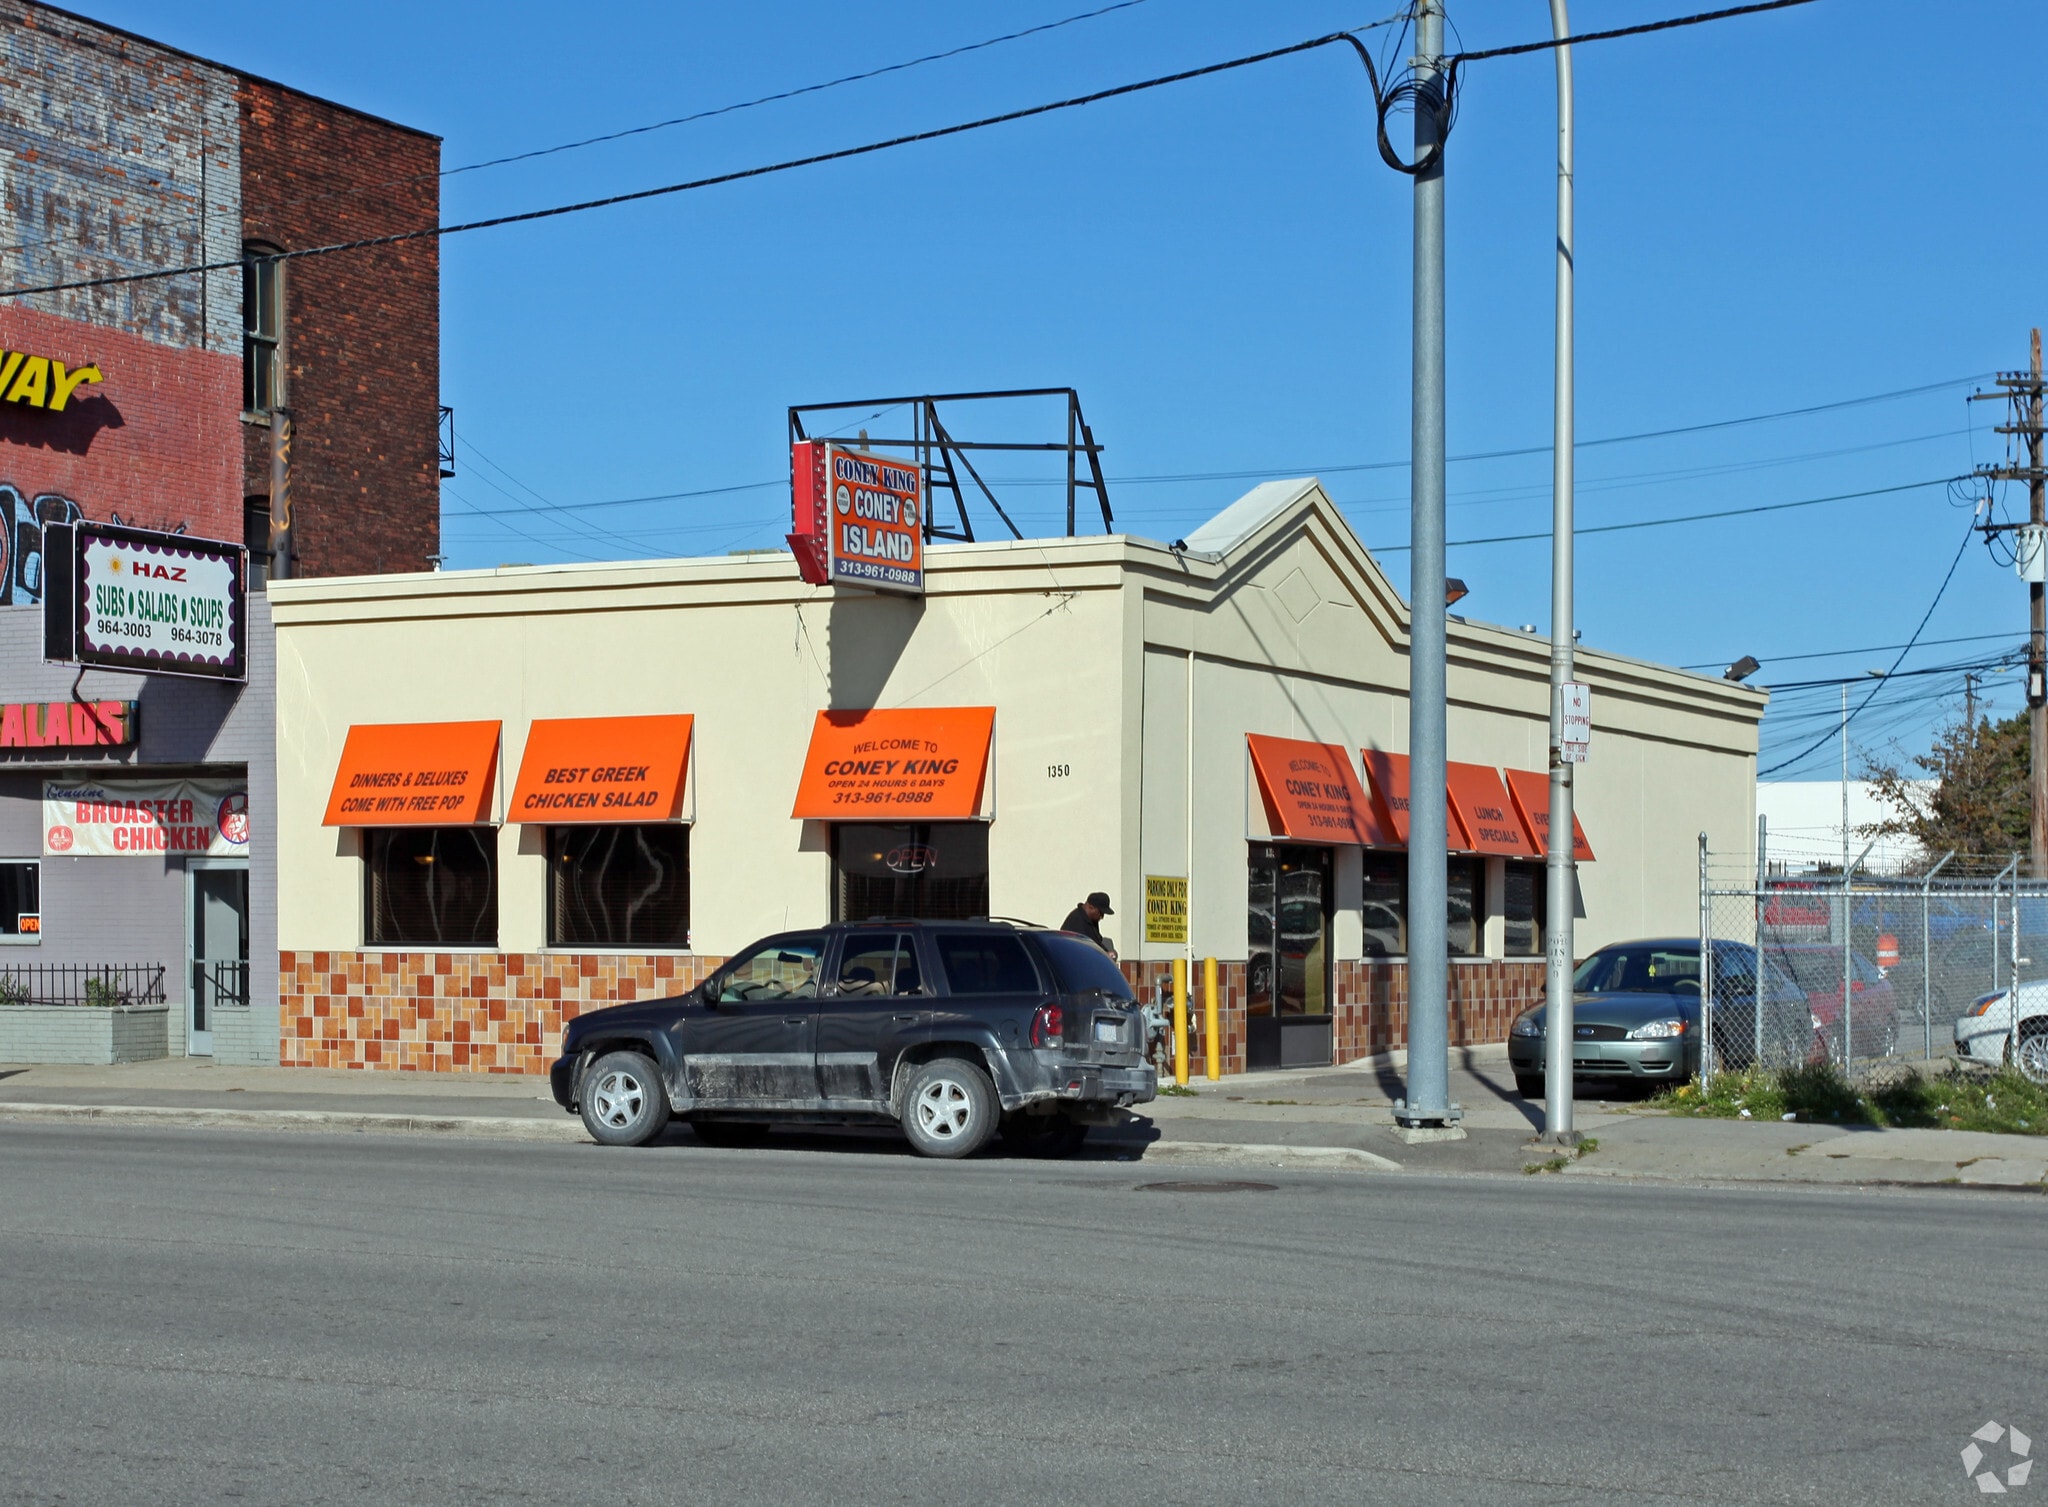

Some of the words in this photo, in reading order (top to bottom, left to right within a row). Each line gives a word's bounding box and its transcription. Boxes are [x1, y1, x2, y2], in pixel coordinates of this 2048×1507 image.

[835, 456, 879, 486] CONEY
[882, 465, 916, 494] KING
[854, 488, 900, 524] CONEY
[842, 524, 913, 562] ISLAND
[132, 561, 187, 583] HAZ
[840, 560, 915, 583] 313-961-0988
[96, 583, 125, 618] SUBS
[137, 589, 178, 624] SALADS
[190, 596, 223, 630] SOUPS
[97, 619, 152, 638] 964-3003
[171, 629, 222, 646] 964-3078
[1573, 697, 1581, 707] NO
[1565, 715, 1589, 726] STOPPING
[853, 739, 920, 755] WELCOME
[924, 741, 938, 753] TO
[544, 768, 589, 784] BEST
[592, 766, 650, 783] GREEK
[824, 760, 899, 776] CONEY
[902, 759, 959, 775] KING
[1047, 764, 1070, 778] 1350
[349, 771, 401, 788] DINNERS
[403, 772, 413, 787] &
[413, 770, 469, 787] DELUXES
[828, 780, 856, 788] OPEN
[857, 780, 870, 788] 24
[872, 780, 907, 788] HOURS
[919, 779, 945, 787] DAYS
[46, 783, 105, 799] Genuine
[833, 791, 934, 804] 313-961-0988
[1286, 779, 1321, 798] CONEY
[1323, 784, 1351, 801] KING
[340, 797, 376, 812] COME
[376, 797, 406, 812] WITH
[408, 796, 439, 811] FREE
[439, 795, 465, 810] POP
[523, 793, 599, 809] CHICKEN
[601, 791, 658, 807] SALAD
[75, 799, 194, 824] BROASTER
[1473, 806, 1504, 822] LUNCH
[113, 826, 210, 851] CHICKEN
[1478, 828, 1519, 844] SPECIALS
[886, 848, 938, 868] OPEN
[1147, 879, 1166, 897] PARKING
[1167, 881, 1178, 897] ONLY
[1147, 899, 1169, 915] CONEY
[1170, 900, 1187, 916] KING
[20, 918, 40, 932] OPEN
